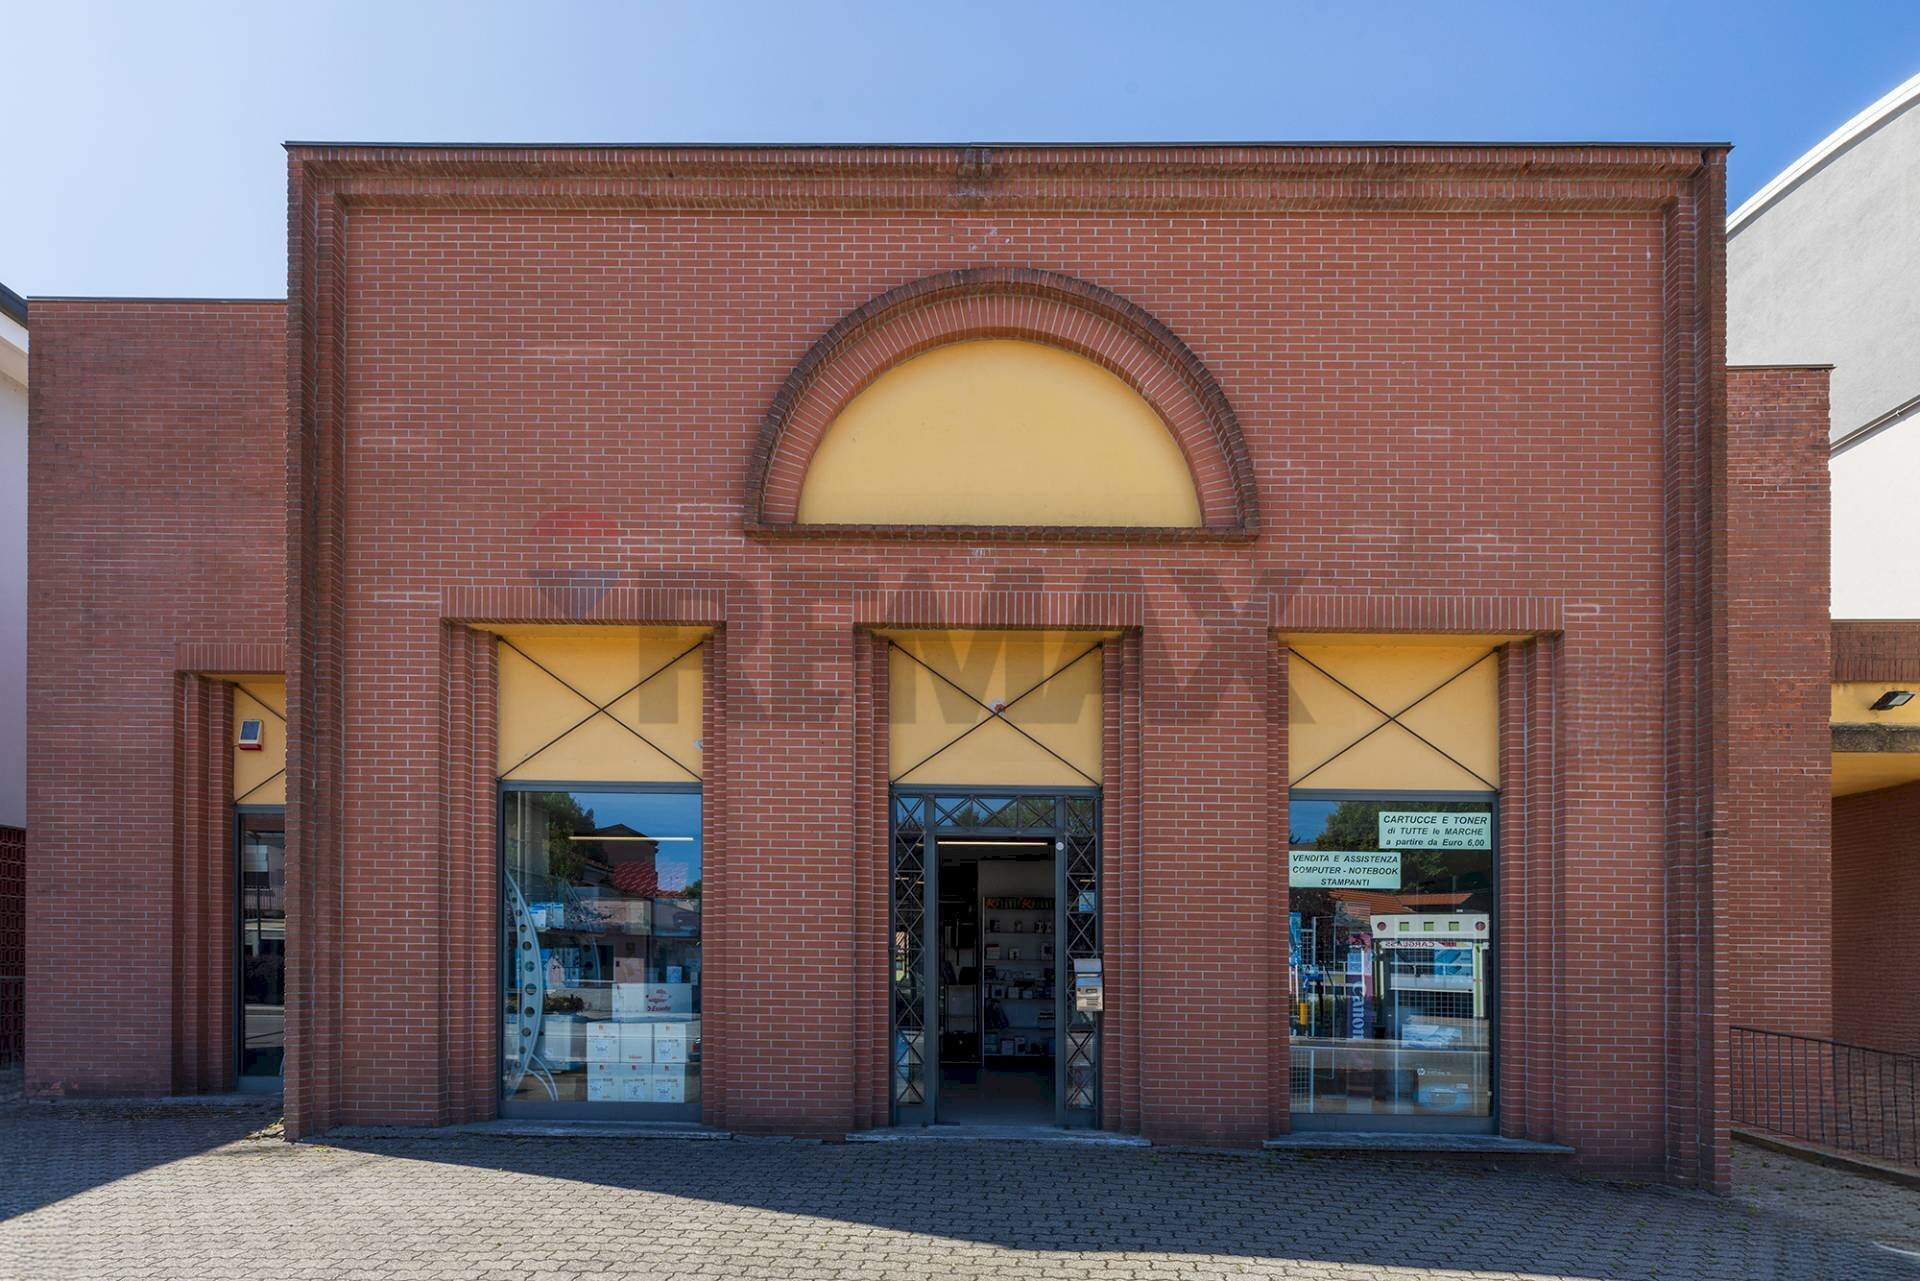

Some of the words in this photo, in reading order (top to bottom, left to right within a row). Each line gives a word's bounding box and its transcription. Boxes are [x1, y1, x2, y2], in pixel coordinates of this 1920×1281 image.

[1383, 815, 1437, 824] CARTUCCE
[1442, 816, 1449, 824] E
[1454, 816, 1488, 825] TONER
[1400, 827, 1429, 835] TUTTE
[1445, 828, 1484, 836] MARCHE
[1395, 839, 1424, 847] partire
[1467, 839, 1485, 847] 6,00
[1292, 854, 1329, 862] VENDITA
[1343, 855, 1398, 863] ASSISTENZA
[1292, 866, 1342, 874] COMPUTER
[1348, 867, 1399, 875] NOTEBOOK
[1321, 878, 1370, 886] STAMPANTI
[1352, 981, 1366, 1041] Canon
